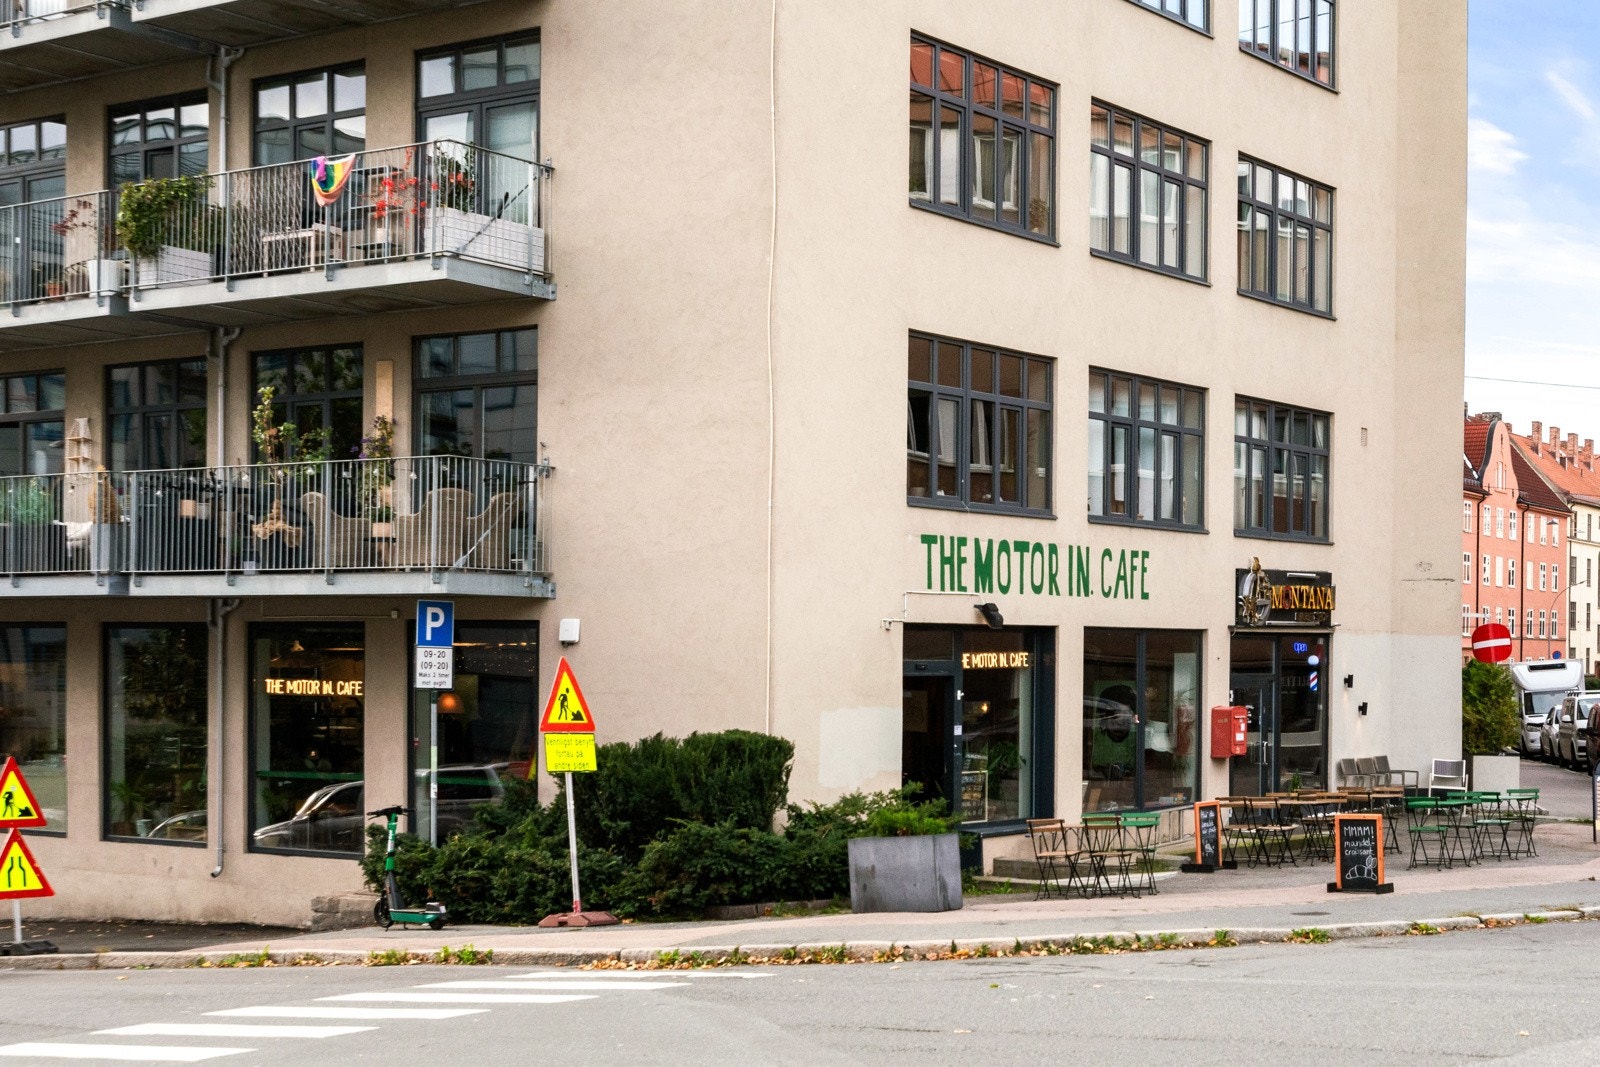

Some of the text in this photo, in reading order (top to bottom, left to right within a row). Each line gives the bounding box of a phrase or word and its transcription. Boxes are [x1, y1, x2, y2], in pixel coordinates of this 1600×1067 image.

[920, 534, 1150, 600] THE MOTOR IN. CAFE
[1271, 585, 1334, 609] MONTANA
[426, 606, 445, 641] P
[424, 650, 446, 659] 09-20
[972, 653, 998, 668] MOTOR
[1010, 652, 1029, 667] CAFE
[421, 662, 449, 671] (09-20)
[265, 679, 284, 694] THE
[286, 680, 320, 695] MOTOR
[336, 681, 363, 696] CAFE
